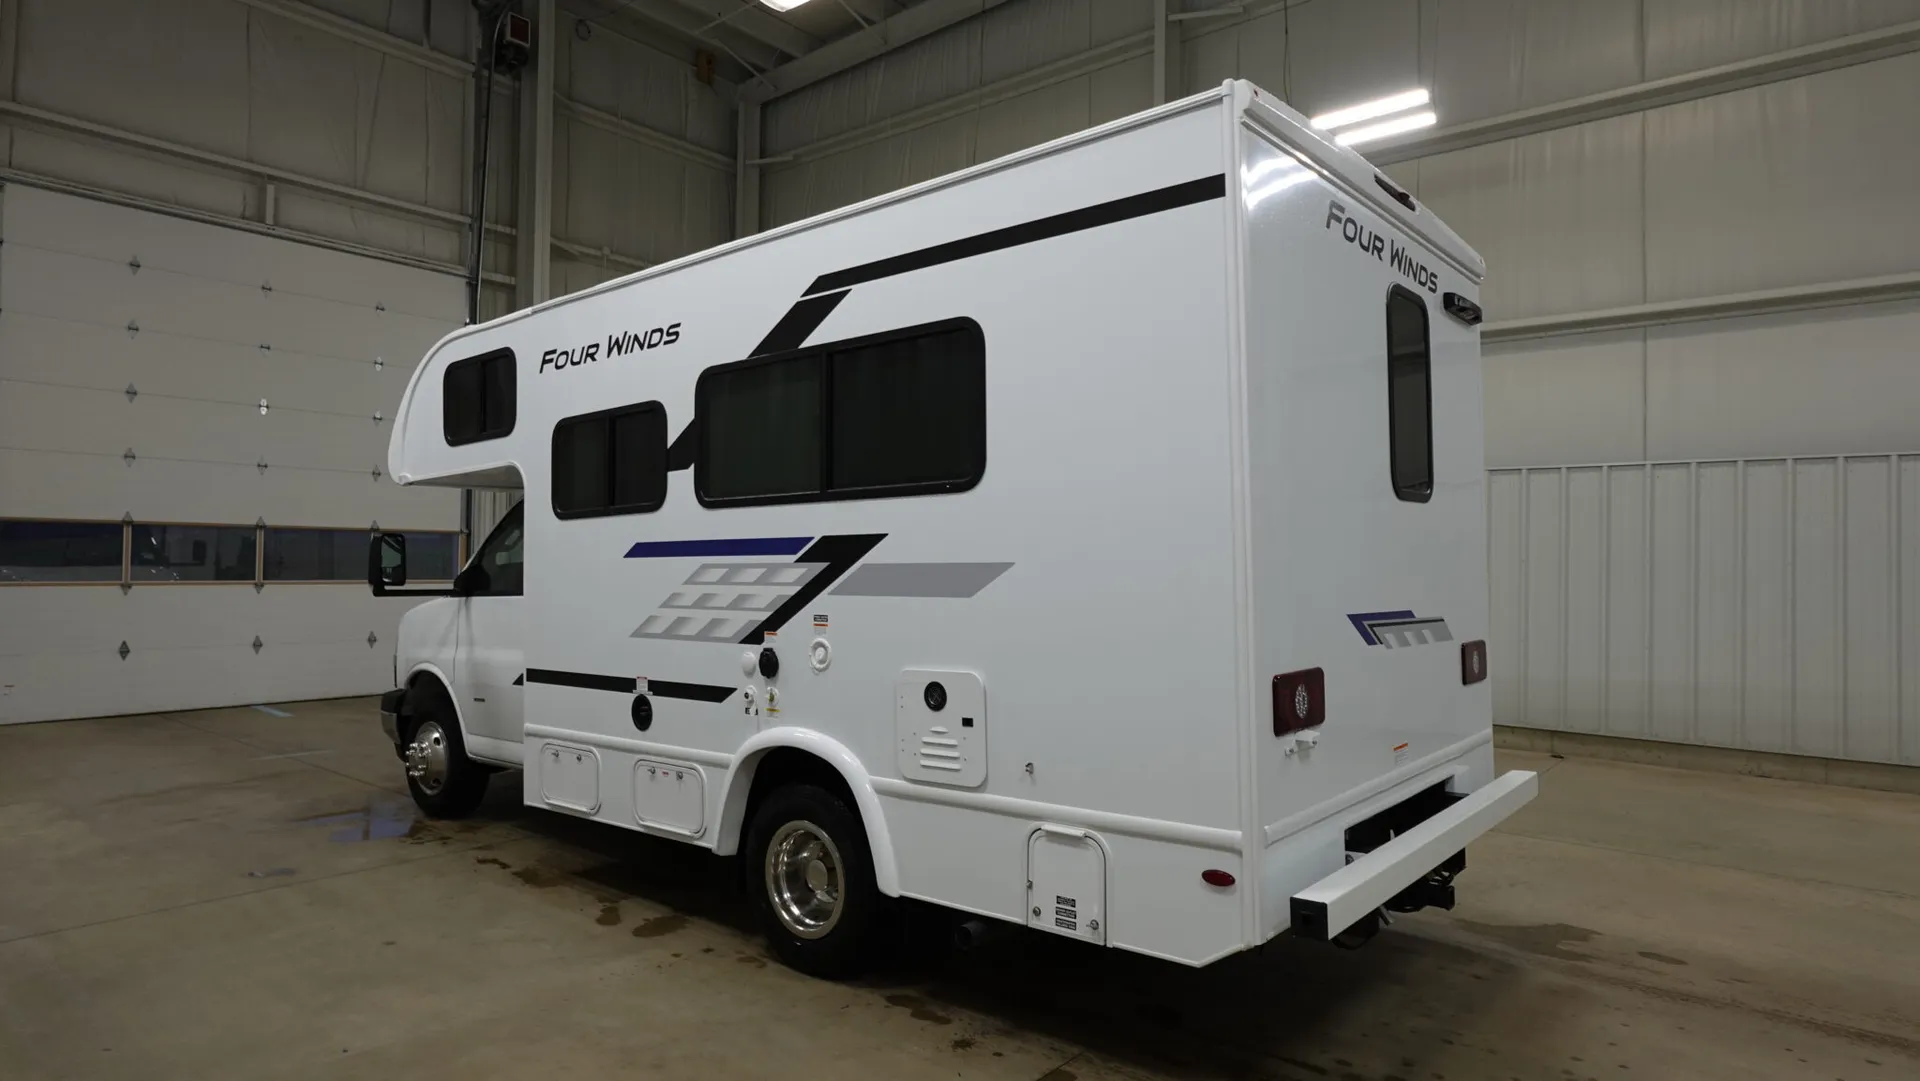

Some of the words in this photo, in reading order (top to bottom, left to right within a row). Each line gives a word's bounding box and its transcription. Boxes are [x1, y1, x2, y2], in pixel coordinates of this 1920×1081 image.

[1326, 200, 1384, 261] FOUR
[1391, 239, 1438, 294] WINDS
[539, 343, 600, 374] FOUR
[607, 322, 682, 358] WINDS
